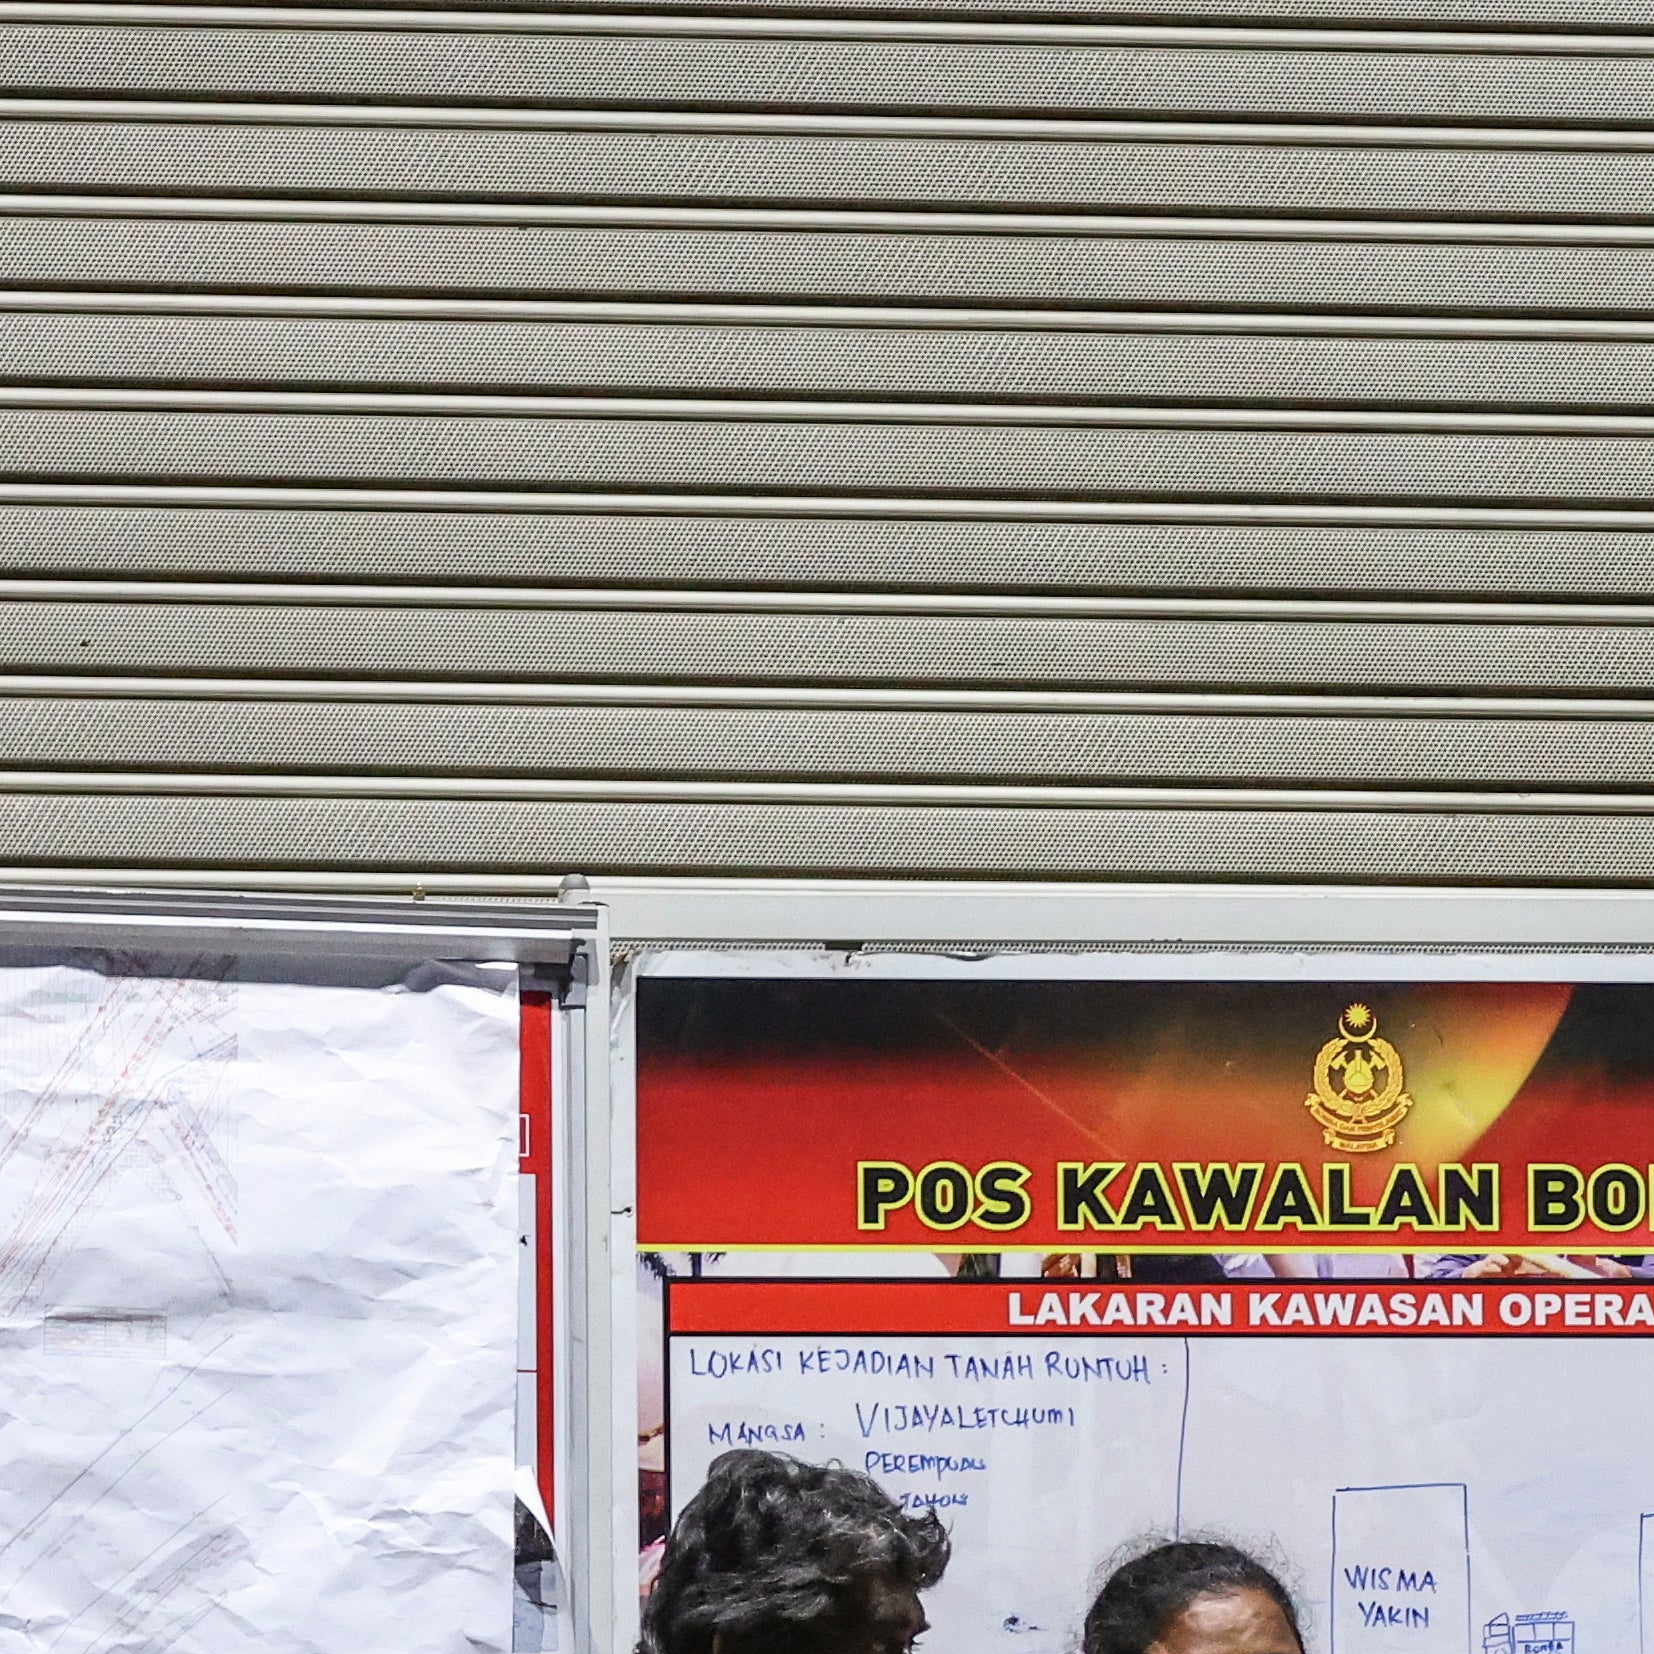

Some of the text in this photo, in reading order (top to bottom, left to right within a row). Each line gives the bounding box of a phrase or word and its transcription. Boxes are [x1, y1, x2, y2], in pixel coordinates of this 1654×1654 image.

[858, 1161, 1031, 1233] POS
[1057, 1161, 1499, 1233] KAWALAN
[1009, 1293, 1231, 1325] LAKARAN
[1250, 1293, 1482, 1325] KAWASAN
[690, 1349, 1150, 1384] LOKASI KEJADIAN TANAH RUNTUH
[1344, 1565, 1437, 1593] WISMA
[1358, 1601, 1429, 1628] YAKIN
